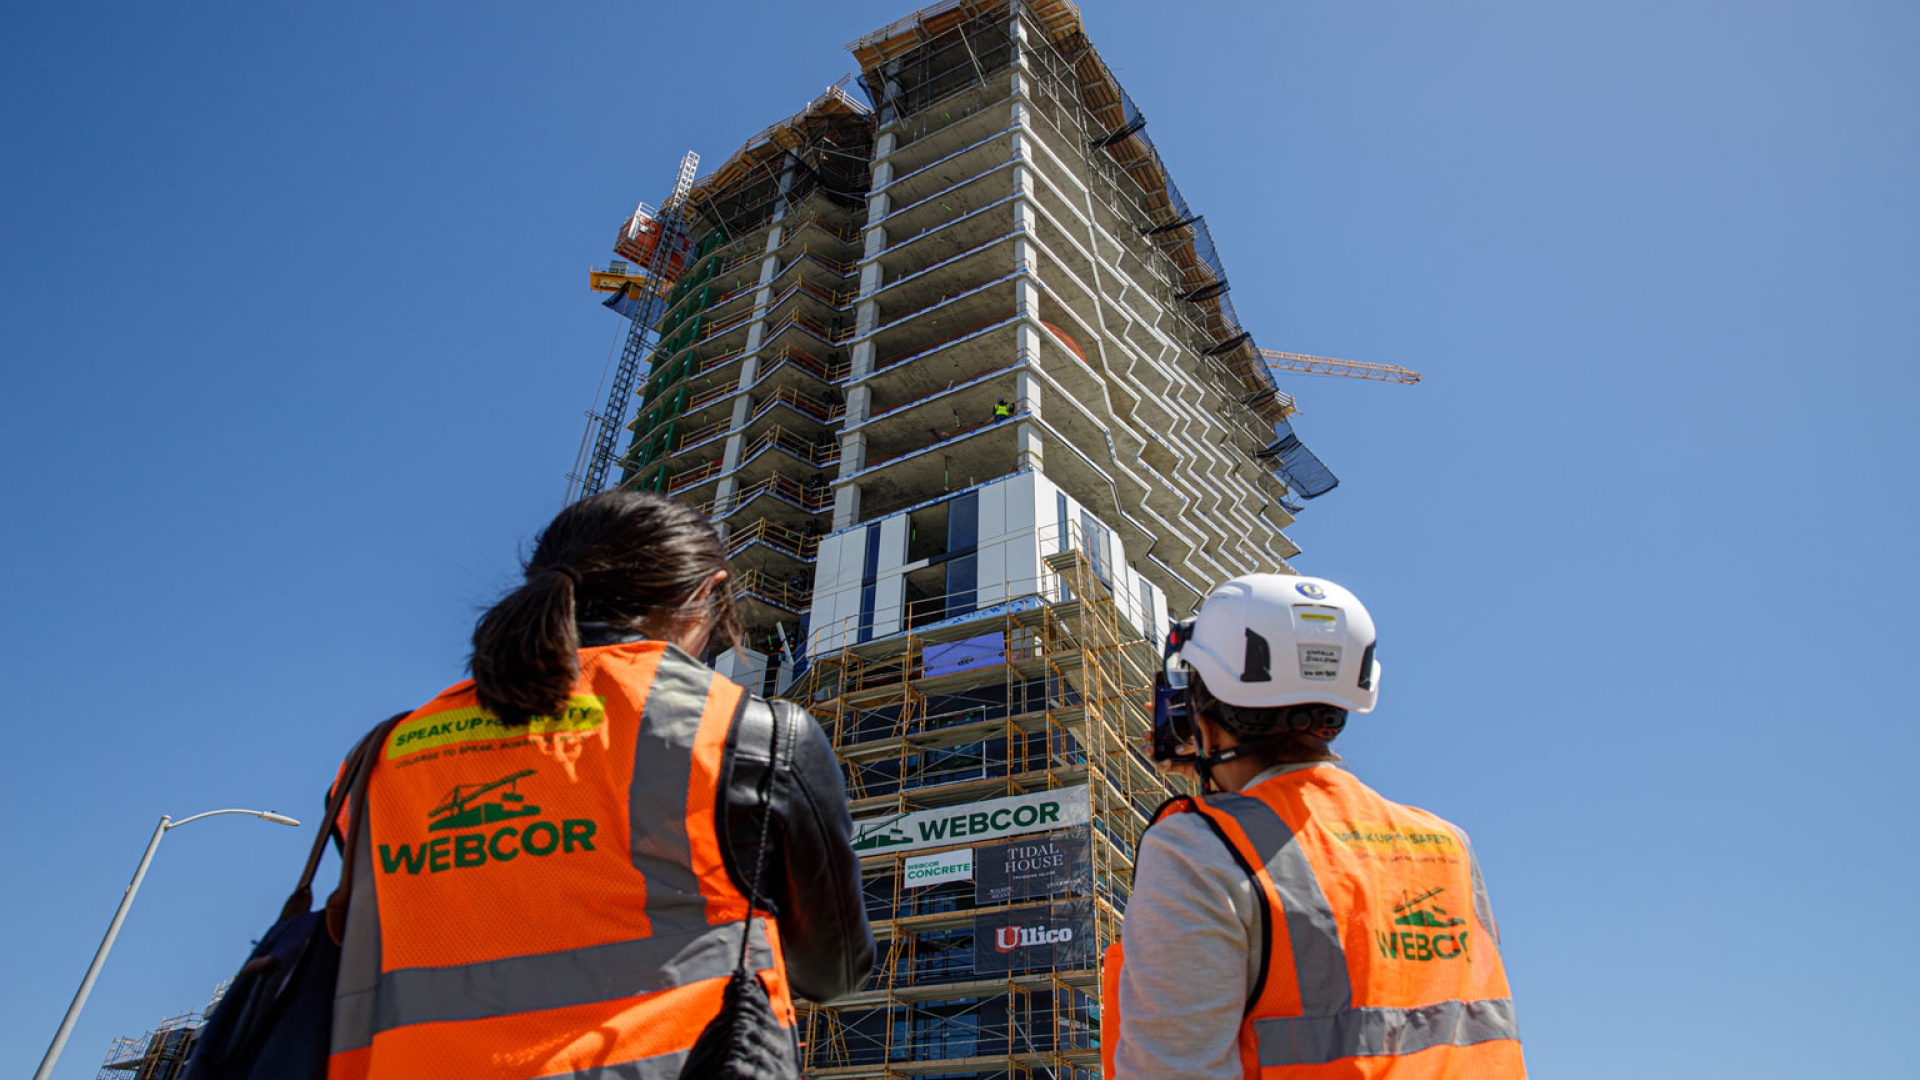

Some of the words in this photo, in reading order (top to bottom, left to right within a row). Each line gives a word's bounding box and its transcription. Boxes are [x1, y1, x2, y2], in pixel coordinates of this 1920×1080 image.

[396, 723, 453, 747] SPEAK
[455, 717, 483, 732] UP
[919, 801, 1060, 842] WEBCOR
[379, 819, 597, 875] WEBCOR
[1007, 843, 1060, 861] TIDAL
[907, 860, 940, 871] WEBCOR
[907, 863, 971, 880] CONCRETE
[1005, 854, 1064, 873] HOUSE
[996, 926, 1072, 950] Ullico
